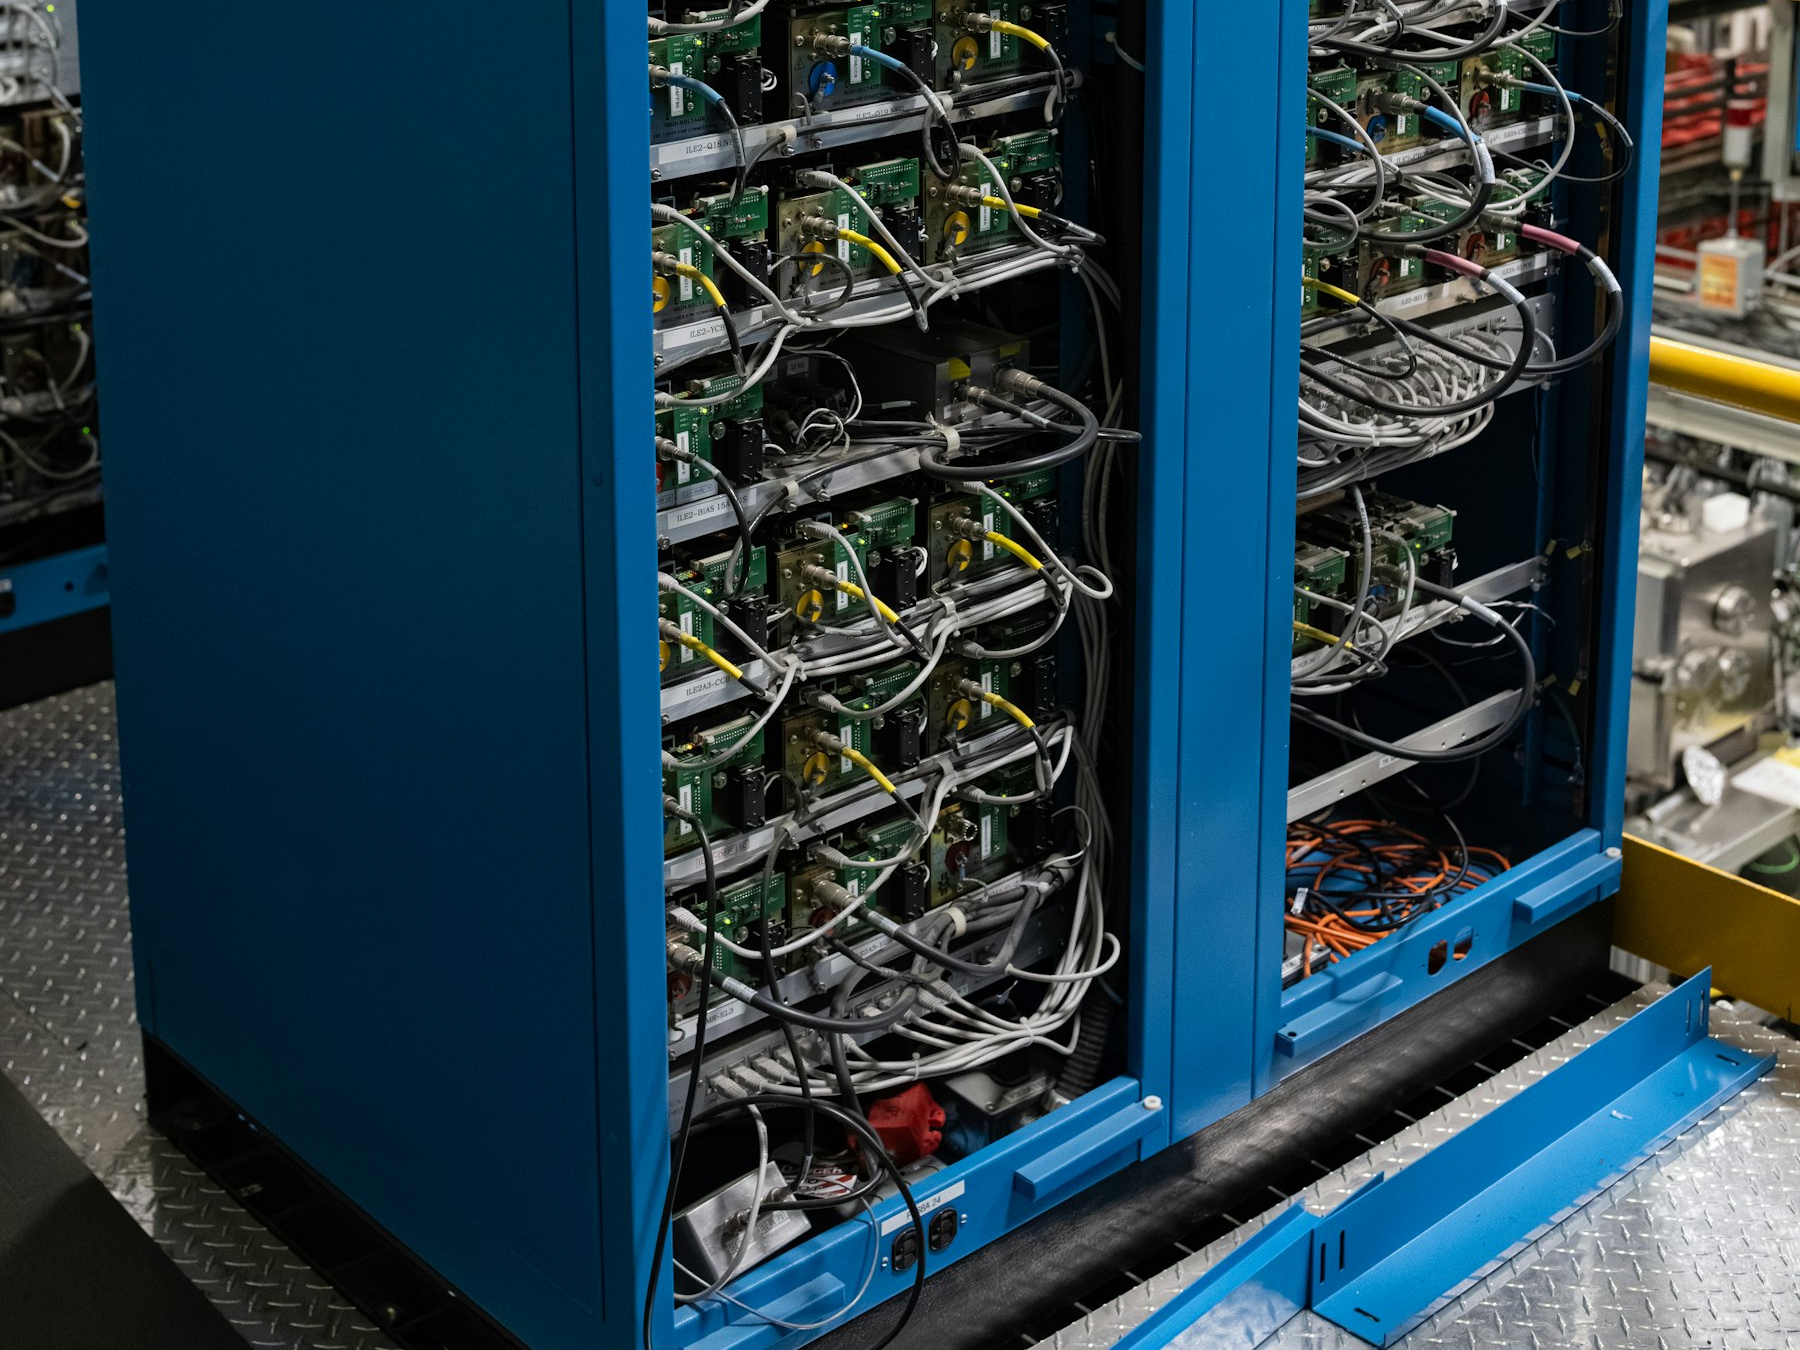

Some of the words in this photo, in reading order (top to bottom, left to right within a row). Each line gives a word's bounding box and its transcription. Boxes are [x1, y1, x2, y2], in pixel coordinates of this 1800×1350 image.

[680, 116, 705, 125] VOLTAGE
[686, 141, 722, 154] ILE2-Q18
[677, 504, 714, 522] ILE2-BIAS
[686, 676, 731, 696] ILE2A3-CCB
[932, 1196, 941, 1207] 24
